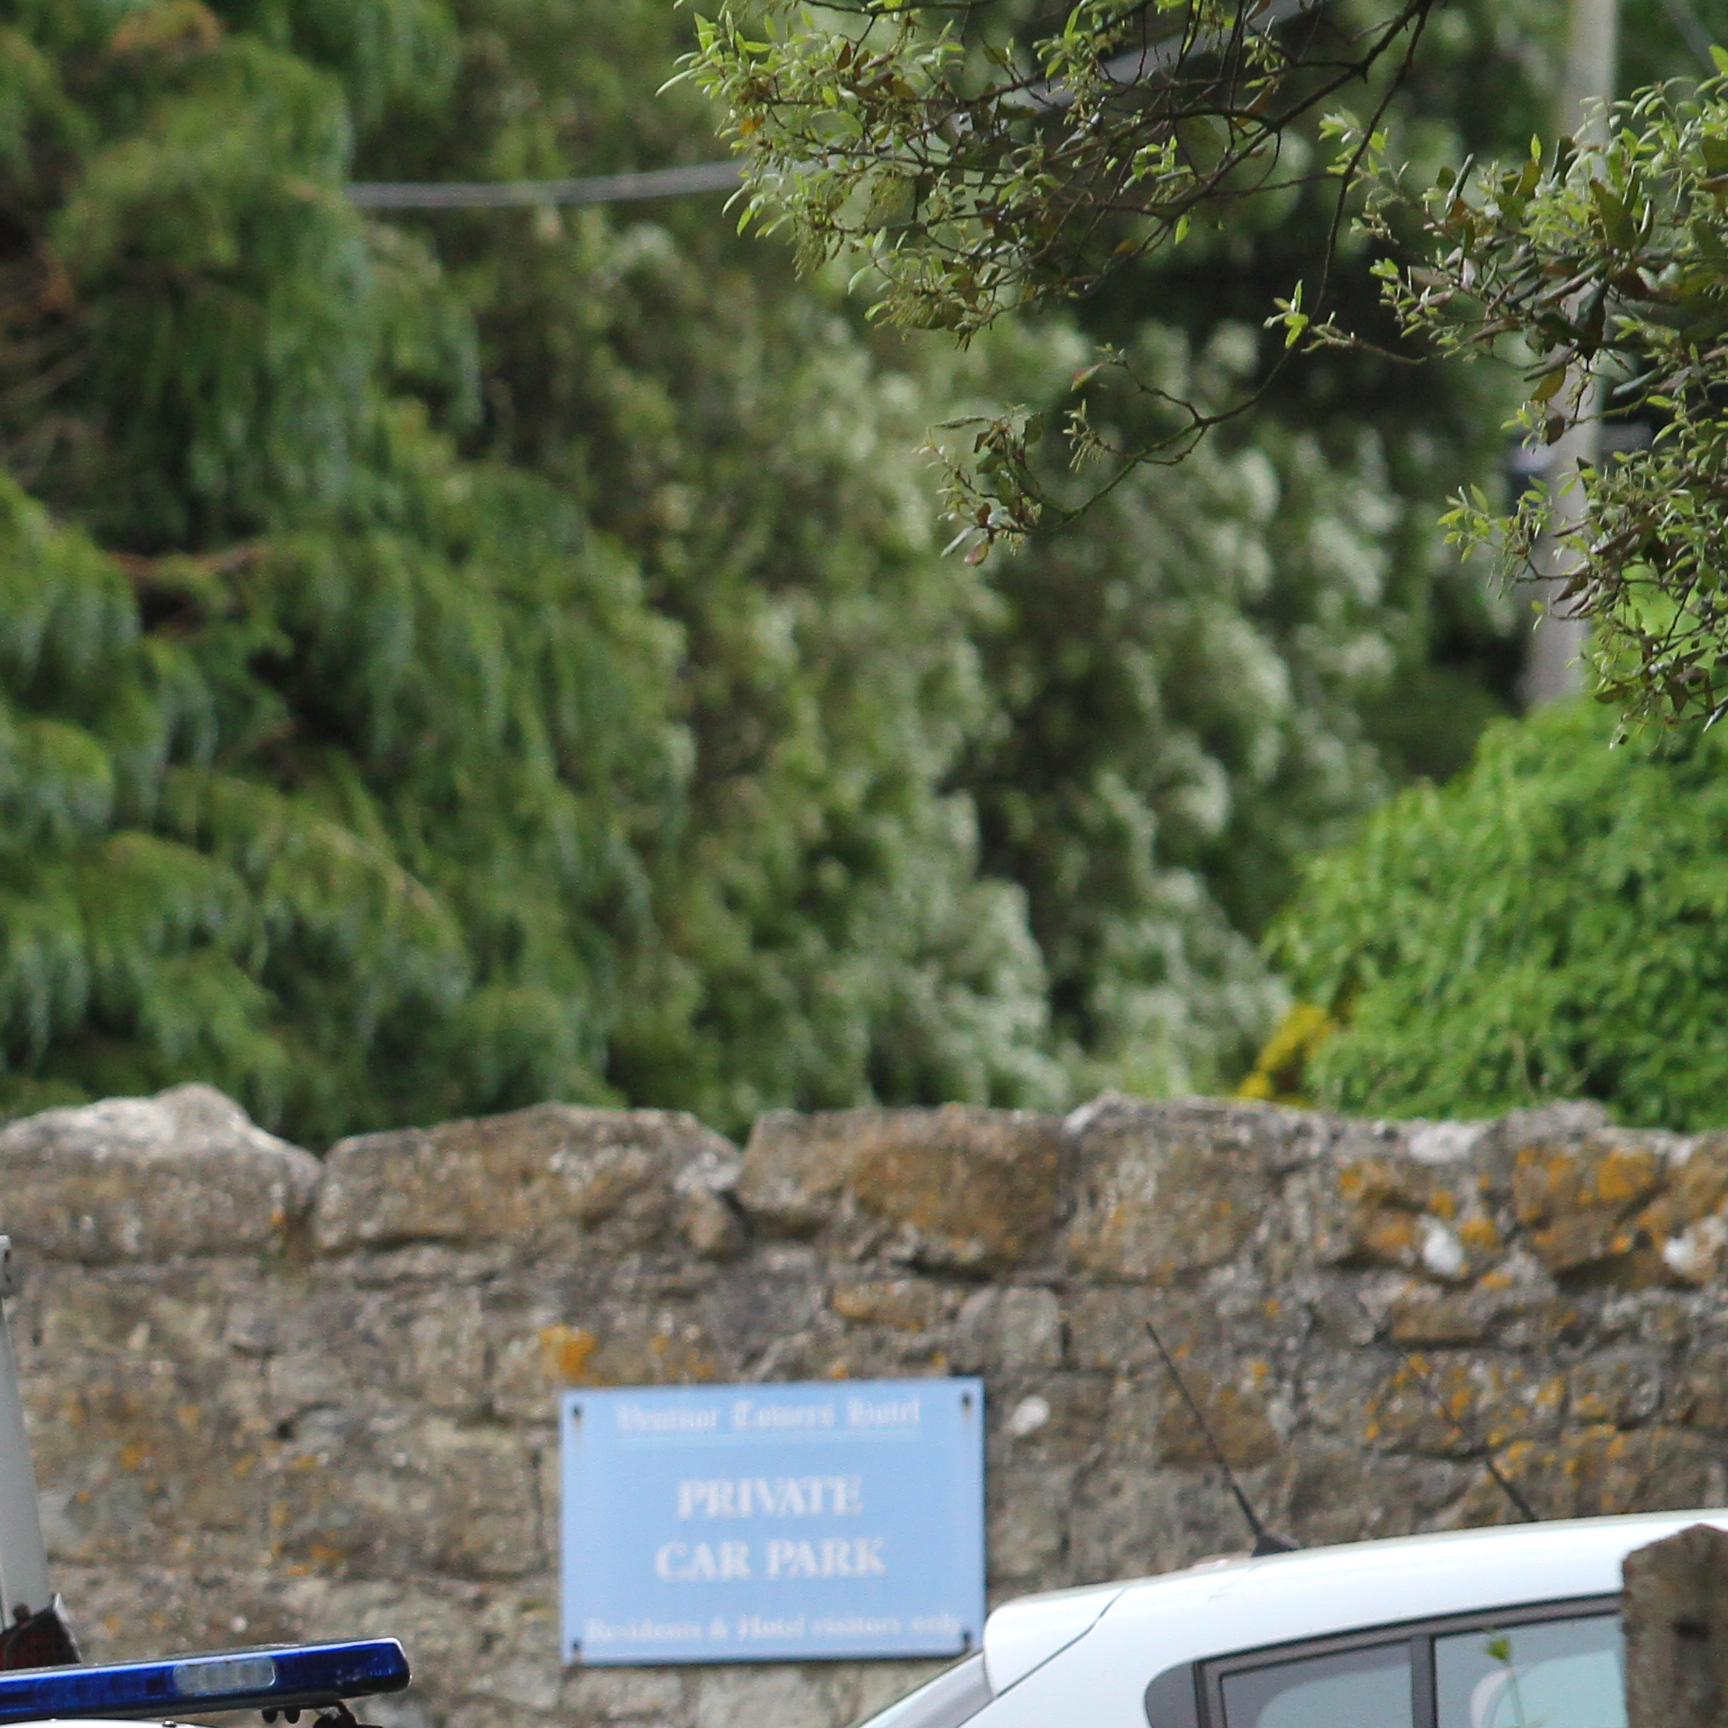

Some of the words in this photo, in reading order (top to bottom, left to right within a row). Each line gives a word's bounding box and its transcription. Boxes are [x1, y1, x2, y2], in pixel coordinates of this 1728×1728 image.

[677, 1475, 864, 1520] PRIVATE
[654, 1539, 751, 1582] CAR
[764, 1536, 887, 1579] PARK
